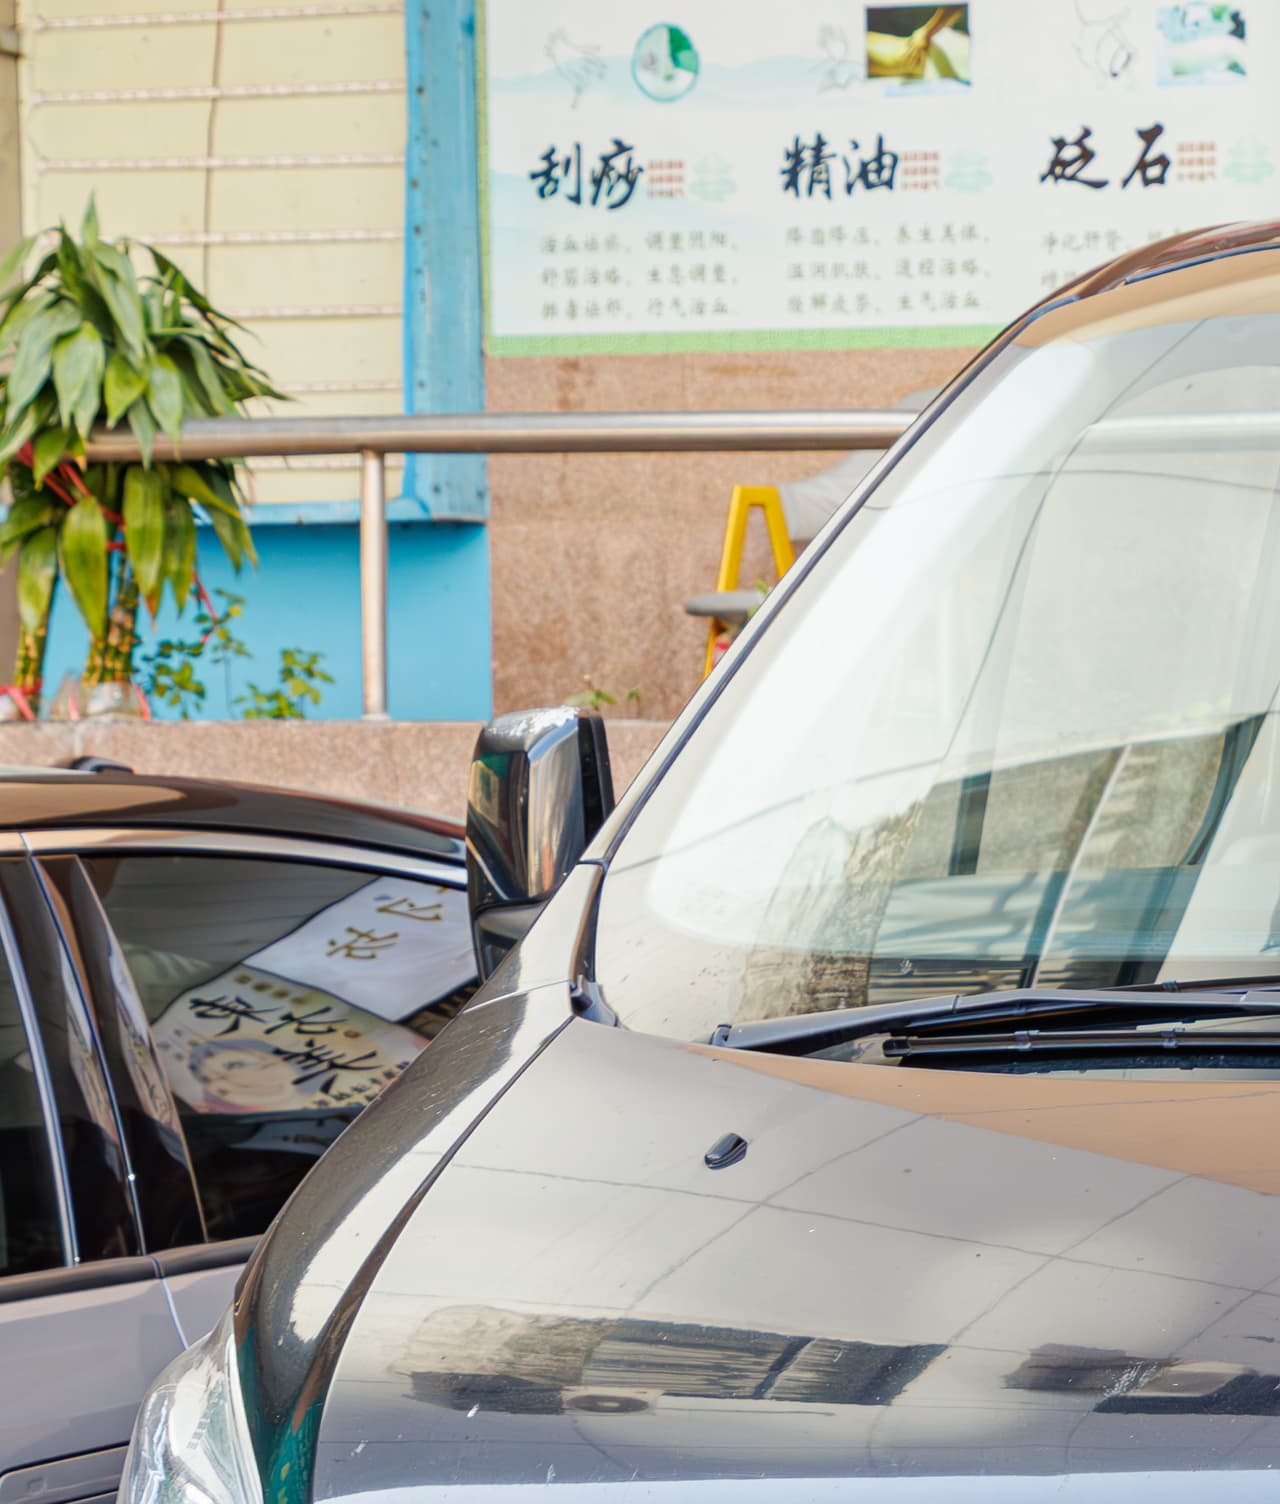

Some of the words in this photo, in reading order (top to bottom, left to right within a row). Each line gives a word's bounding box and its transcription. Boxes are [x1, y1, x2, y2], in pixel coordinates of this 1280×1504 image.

[529, 138, 645, 210] 刮痧
[780, 133, 899, 200] 精油
[1038, 122, 1171, 189] 砭石
